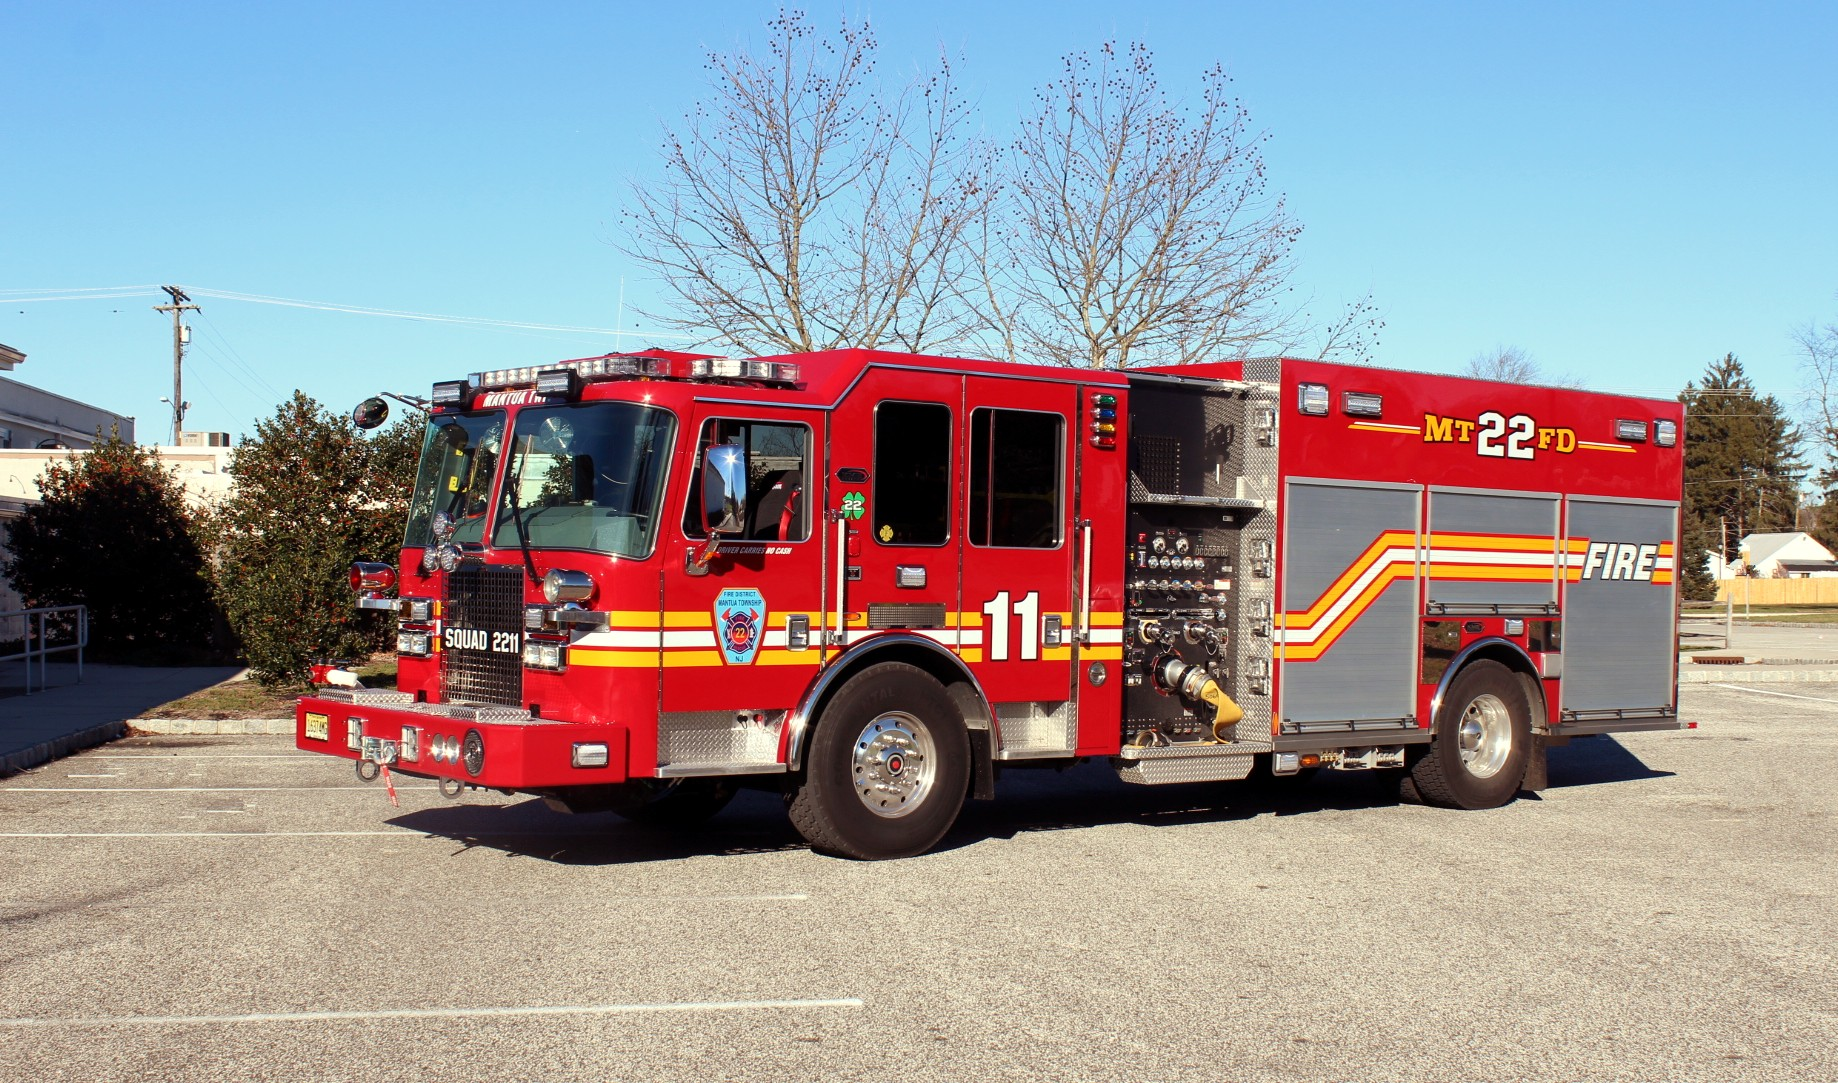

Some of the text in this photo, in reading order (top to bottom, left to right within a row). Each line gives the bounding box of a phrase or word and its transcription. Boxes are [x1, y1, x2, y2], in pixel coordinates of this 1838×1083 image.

[482, 391, 527, 408] MANTUA
[1477, 411, 1535, 460] 22
[1538, 427, 1576, 454] FD
[844, 500, 862, 511] 22
[765, 547, 775, 555] NO
[775, 547, 793, 555] CASH
[1582, 541, 1658, 581] FIRE
[738, 599, 762, 607] TOWNSHIP
[735, 627, 745, 639] 22
[983, 590, 1039, 661] 11
[445, 628, 519, 654] SQUAD 2211
